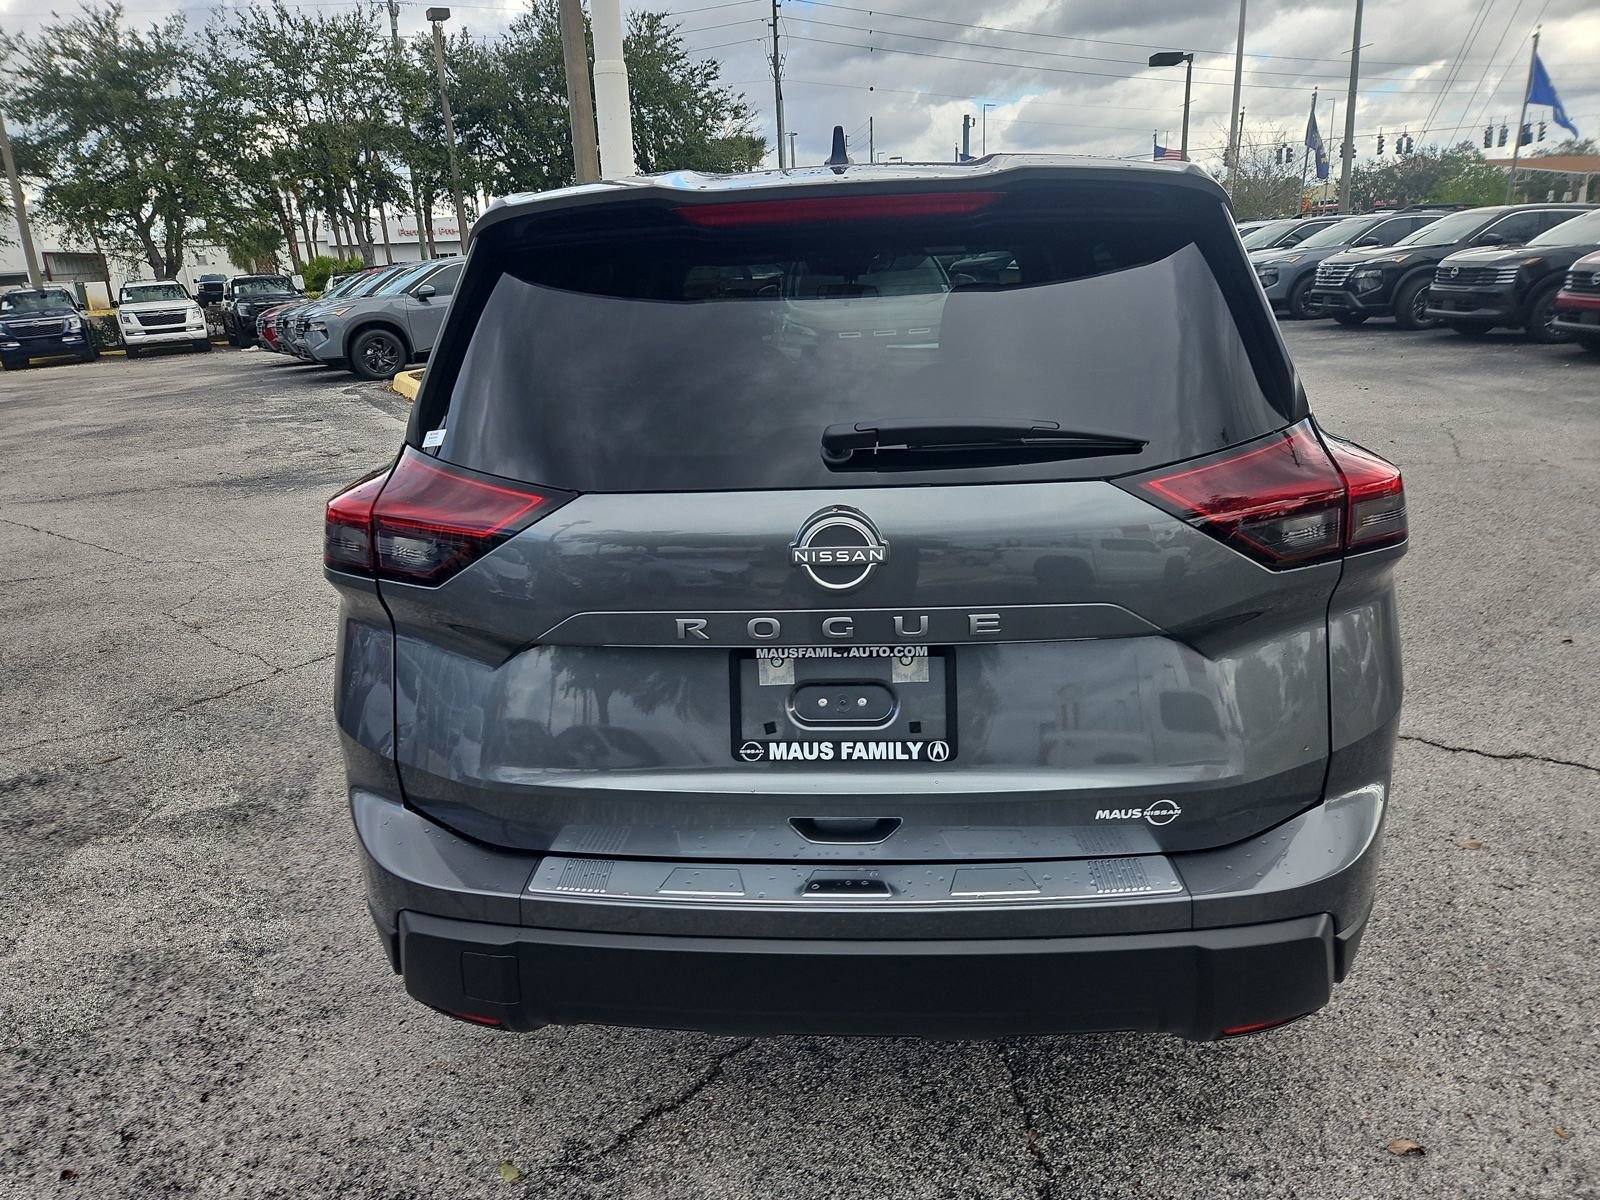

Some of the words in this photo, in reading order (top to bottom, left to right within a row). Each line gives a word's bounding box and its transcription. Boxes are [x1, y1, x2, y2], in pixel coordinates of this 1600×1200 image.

[794, 550, 883, 562] NISSAN
[675, 614, 1001, 639] ROGUE
[769, 742, 834, 760] MAUS
[841, 742, 923, 760] FAMILY
[1095, 808, 1142, 820] MAUS
